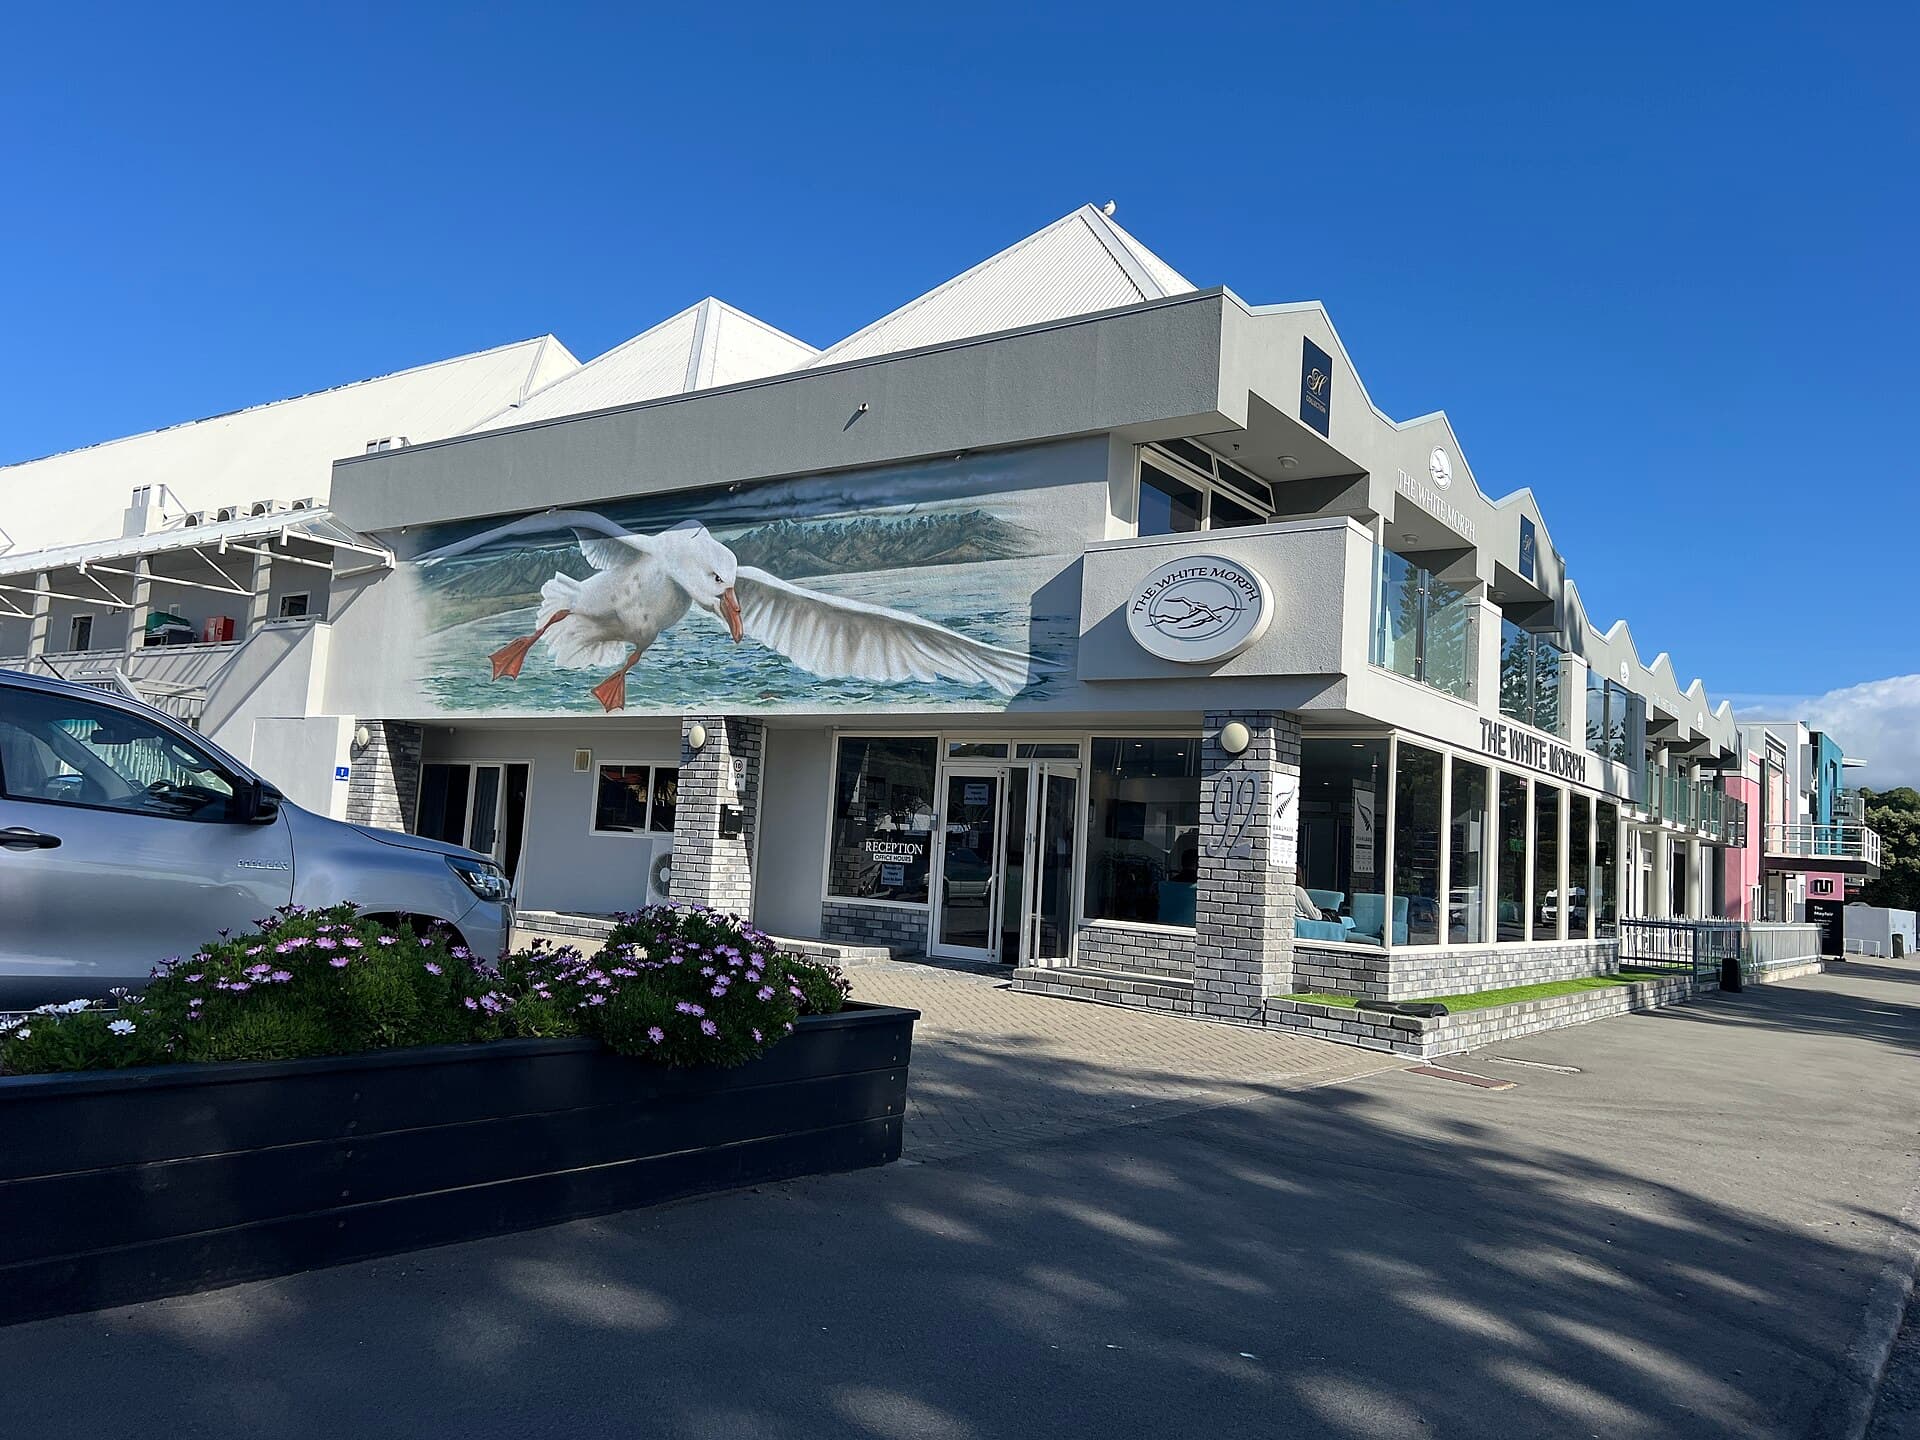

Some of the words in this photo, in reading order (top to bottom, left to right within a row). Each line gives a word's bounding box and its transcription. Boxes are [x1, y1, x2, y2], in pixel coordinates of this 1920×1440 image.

[1306, 394, 1326, 414] COLLECTION
[1398, 467, 1416, 499] THE
[1417, 482, 1446, 520] WHITE
[1447, 504, 1476, 542] MORPH
[1132, 587, 1156, 614] THE
[1154, 567, 1208, 589] WHITE
[1210, 567, 1260, 602] MORPH
[1479, 717, 1507, 757] THE
[1509, 728, 1547, 770] WHITE
[1549, 743, 1586, 783] MORPH
[1205, 769, 1260, 859] 92
[865, 841, 924, 855] RECEPTION
